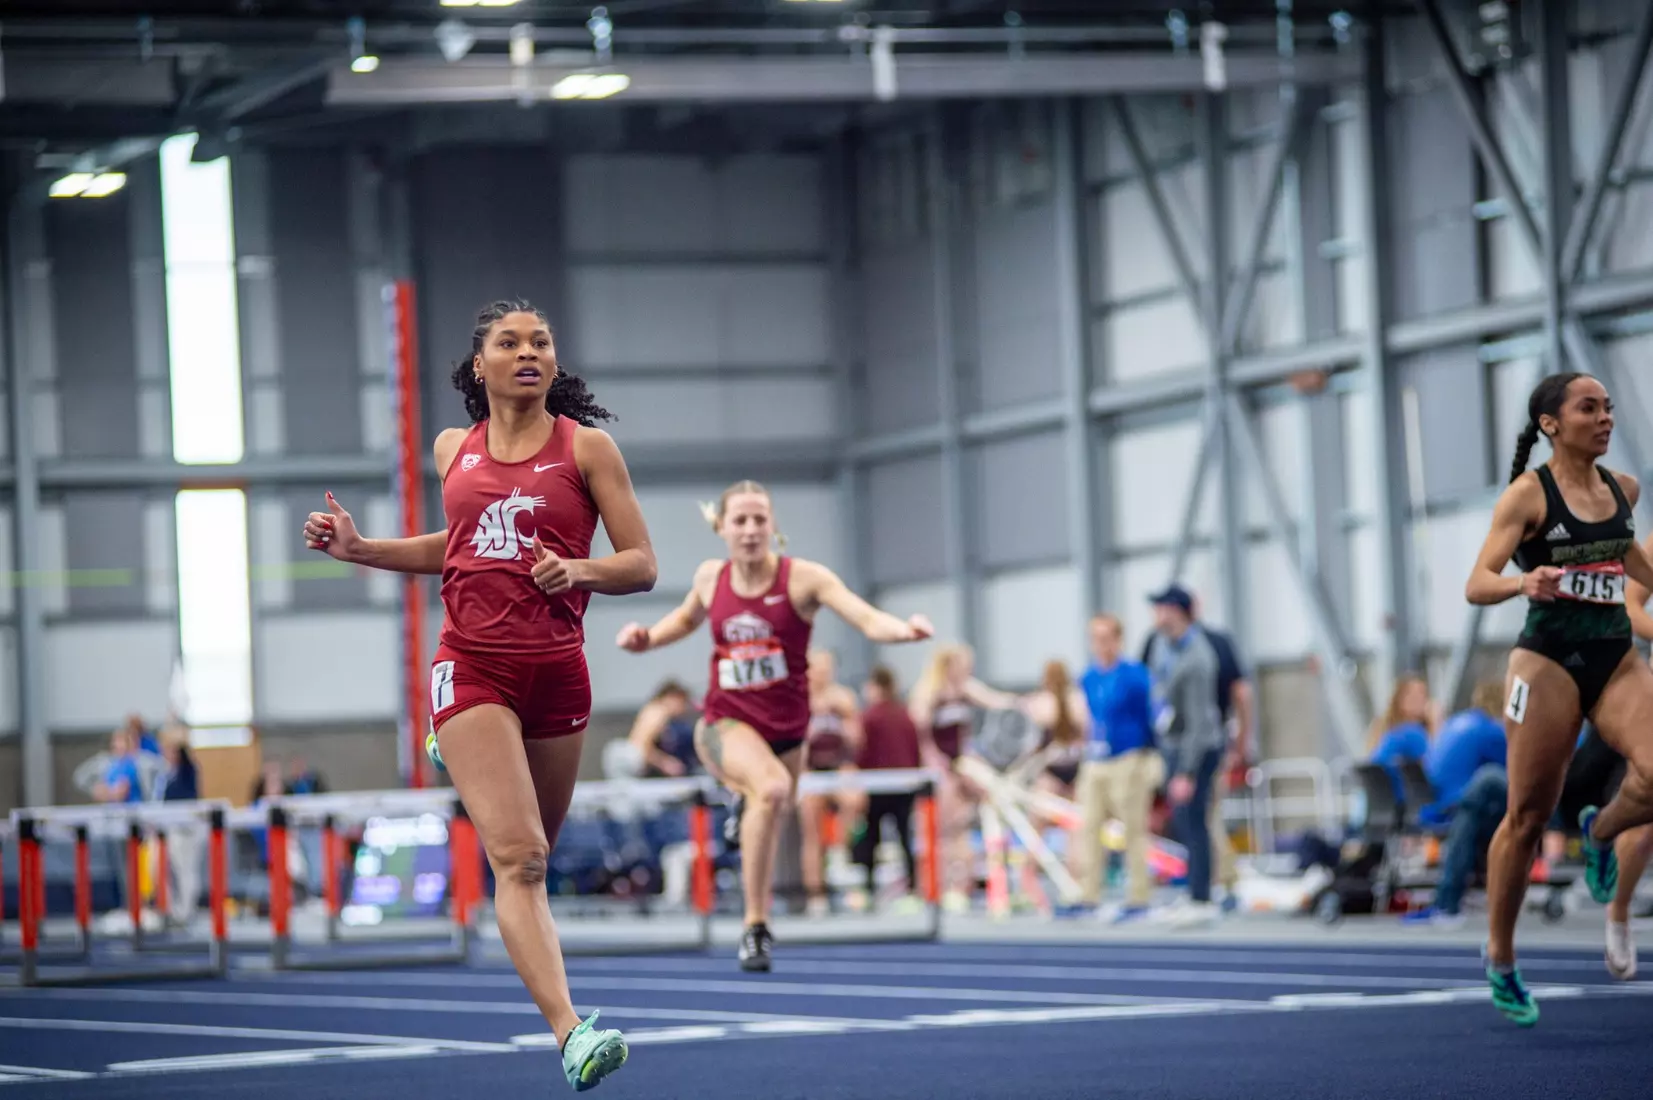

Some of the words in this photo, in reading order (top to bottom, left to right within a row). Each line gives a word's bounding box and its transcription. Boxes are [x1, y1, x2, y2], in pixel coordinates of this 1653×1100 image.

[1572, 570, 1615, 600] 615
[435, 662, 448, 709] 7
[732, 656, 775, 684] 176
[1511, 684, 1523, 718] 4
